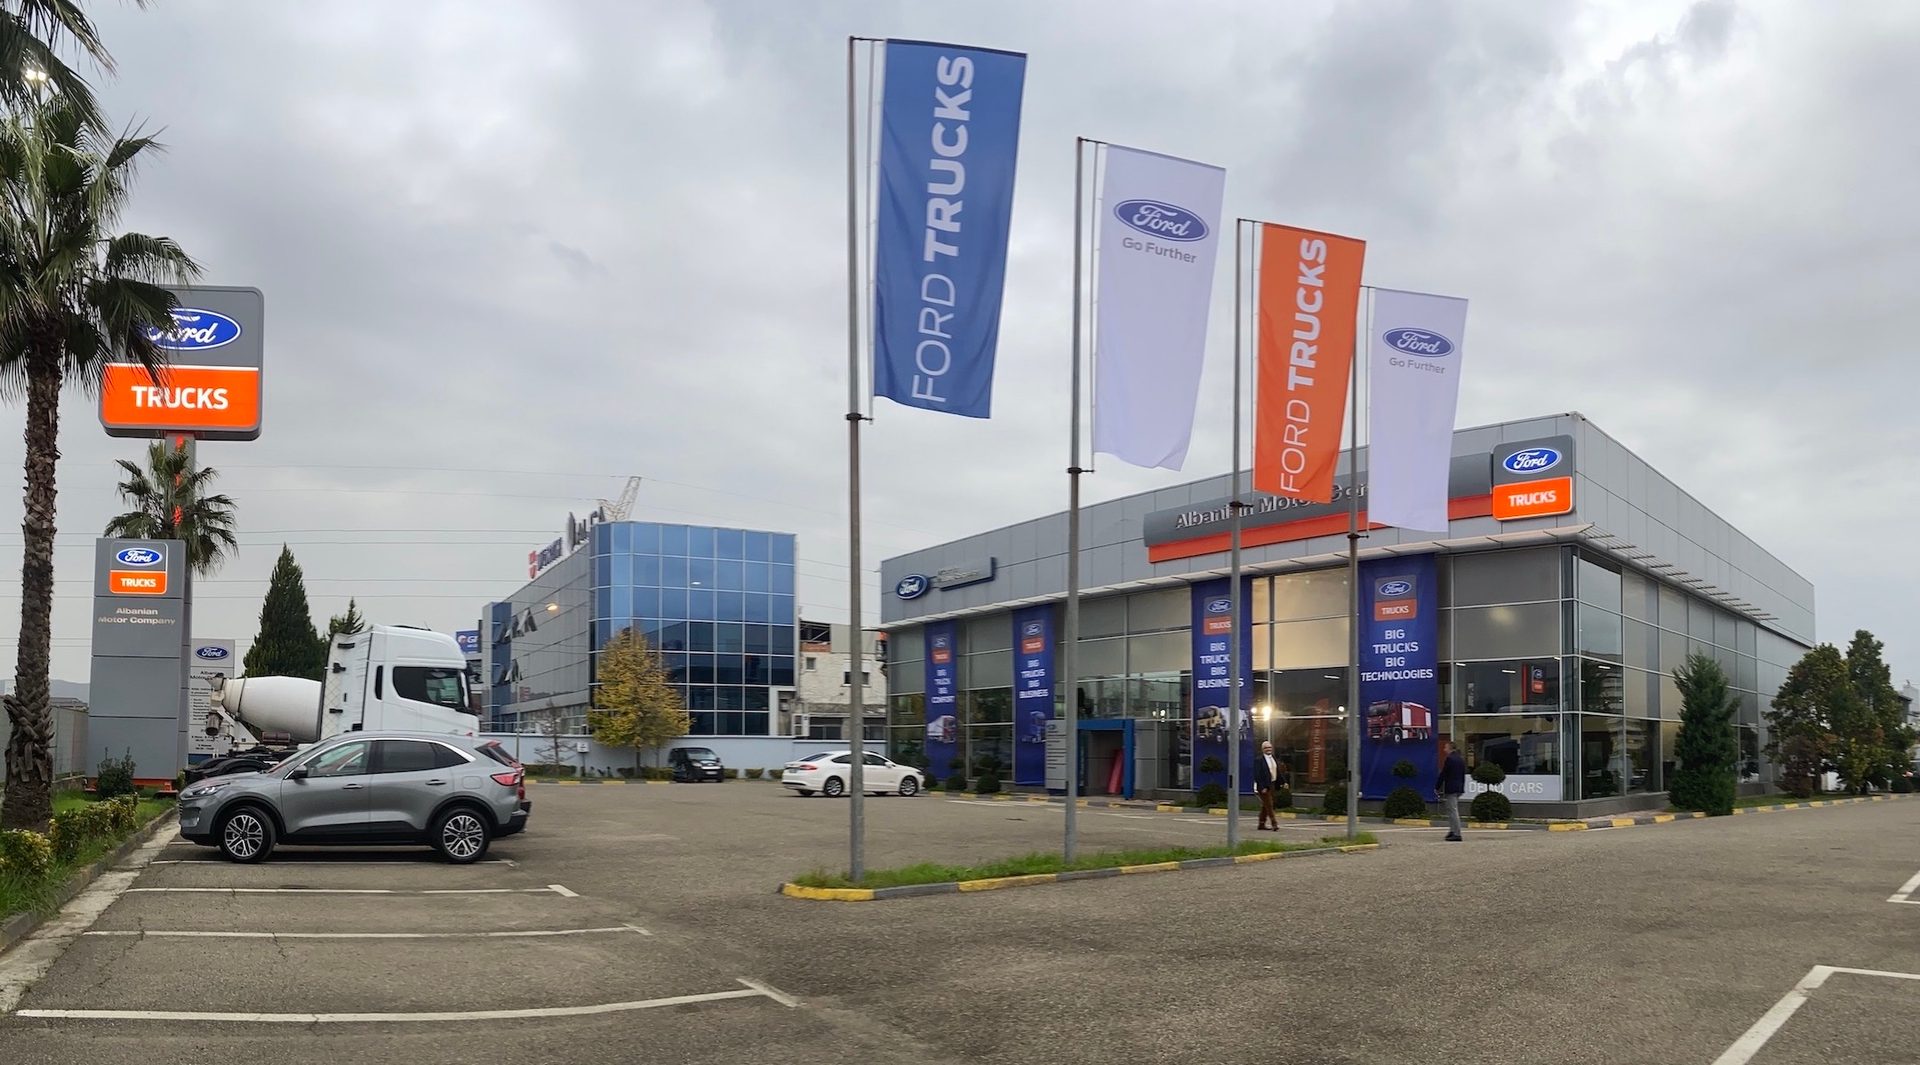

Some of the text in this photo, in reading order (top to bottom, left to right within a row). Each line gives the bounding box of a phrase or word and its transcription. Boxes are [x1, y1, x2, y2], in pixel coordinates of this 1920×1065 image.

[1132, 204, 1192, 236] Ford
[911, 55, 975, 403] FORD TRUCKS
[1122, 237, 1198, 264] Go Further
[1396, 331, 1441, 354] Ford
[1280, 238, 1328, 493] FORD TRUCKS
[1389, 357, 1447, 375] Go Further
[131, 385, 229, 410] TRUCKS
[1513, 451, 1549, 470] Ford
[1508, 490, 1557, 508] TRUCKS
[124, 550, 153, 563] Ford
[120, 577, 157, 588] TRUCKS
[116, 607, 158, 615] Albanian
[1381, 605, 1410, 615] TRUCKS
[97, 615, 176, 625] Motor Company
[1385, 628, 1405, 640] BIG
[202, 647, 222, 657] Ford
[1210, 642, 1226, 652] BIG
[1372, 641, 1419, 654] TRUCKS
[1385, 656, 1405, 668] BIG
[1211, 666, 1227, 676] BIG
[1360, 668, 1434, 682] TECHNOLOGIES
[1197, 677, 1244, 689] BUSINES
[1509, 782, 1544, 794] CARS
